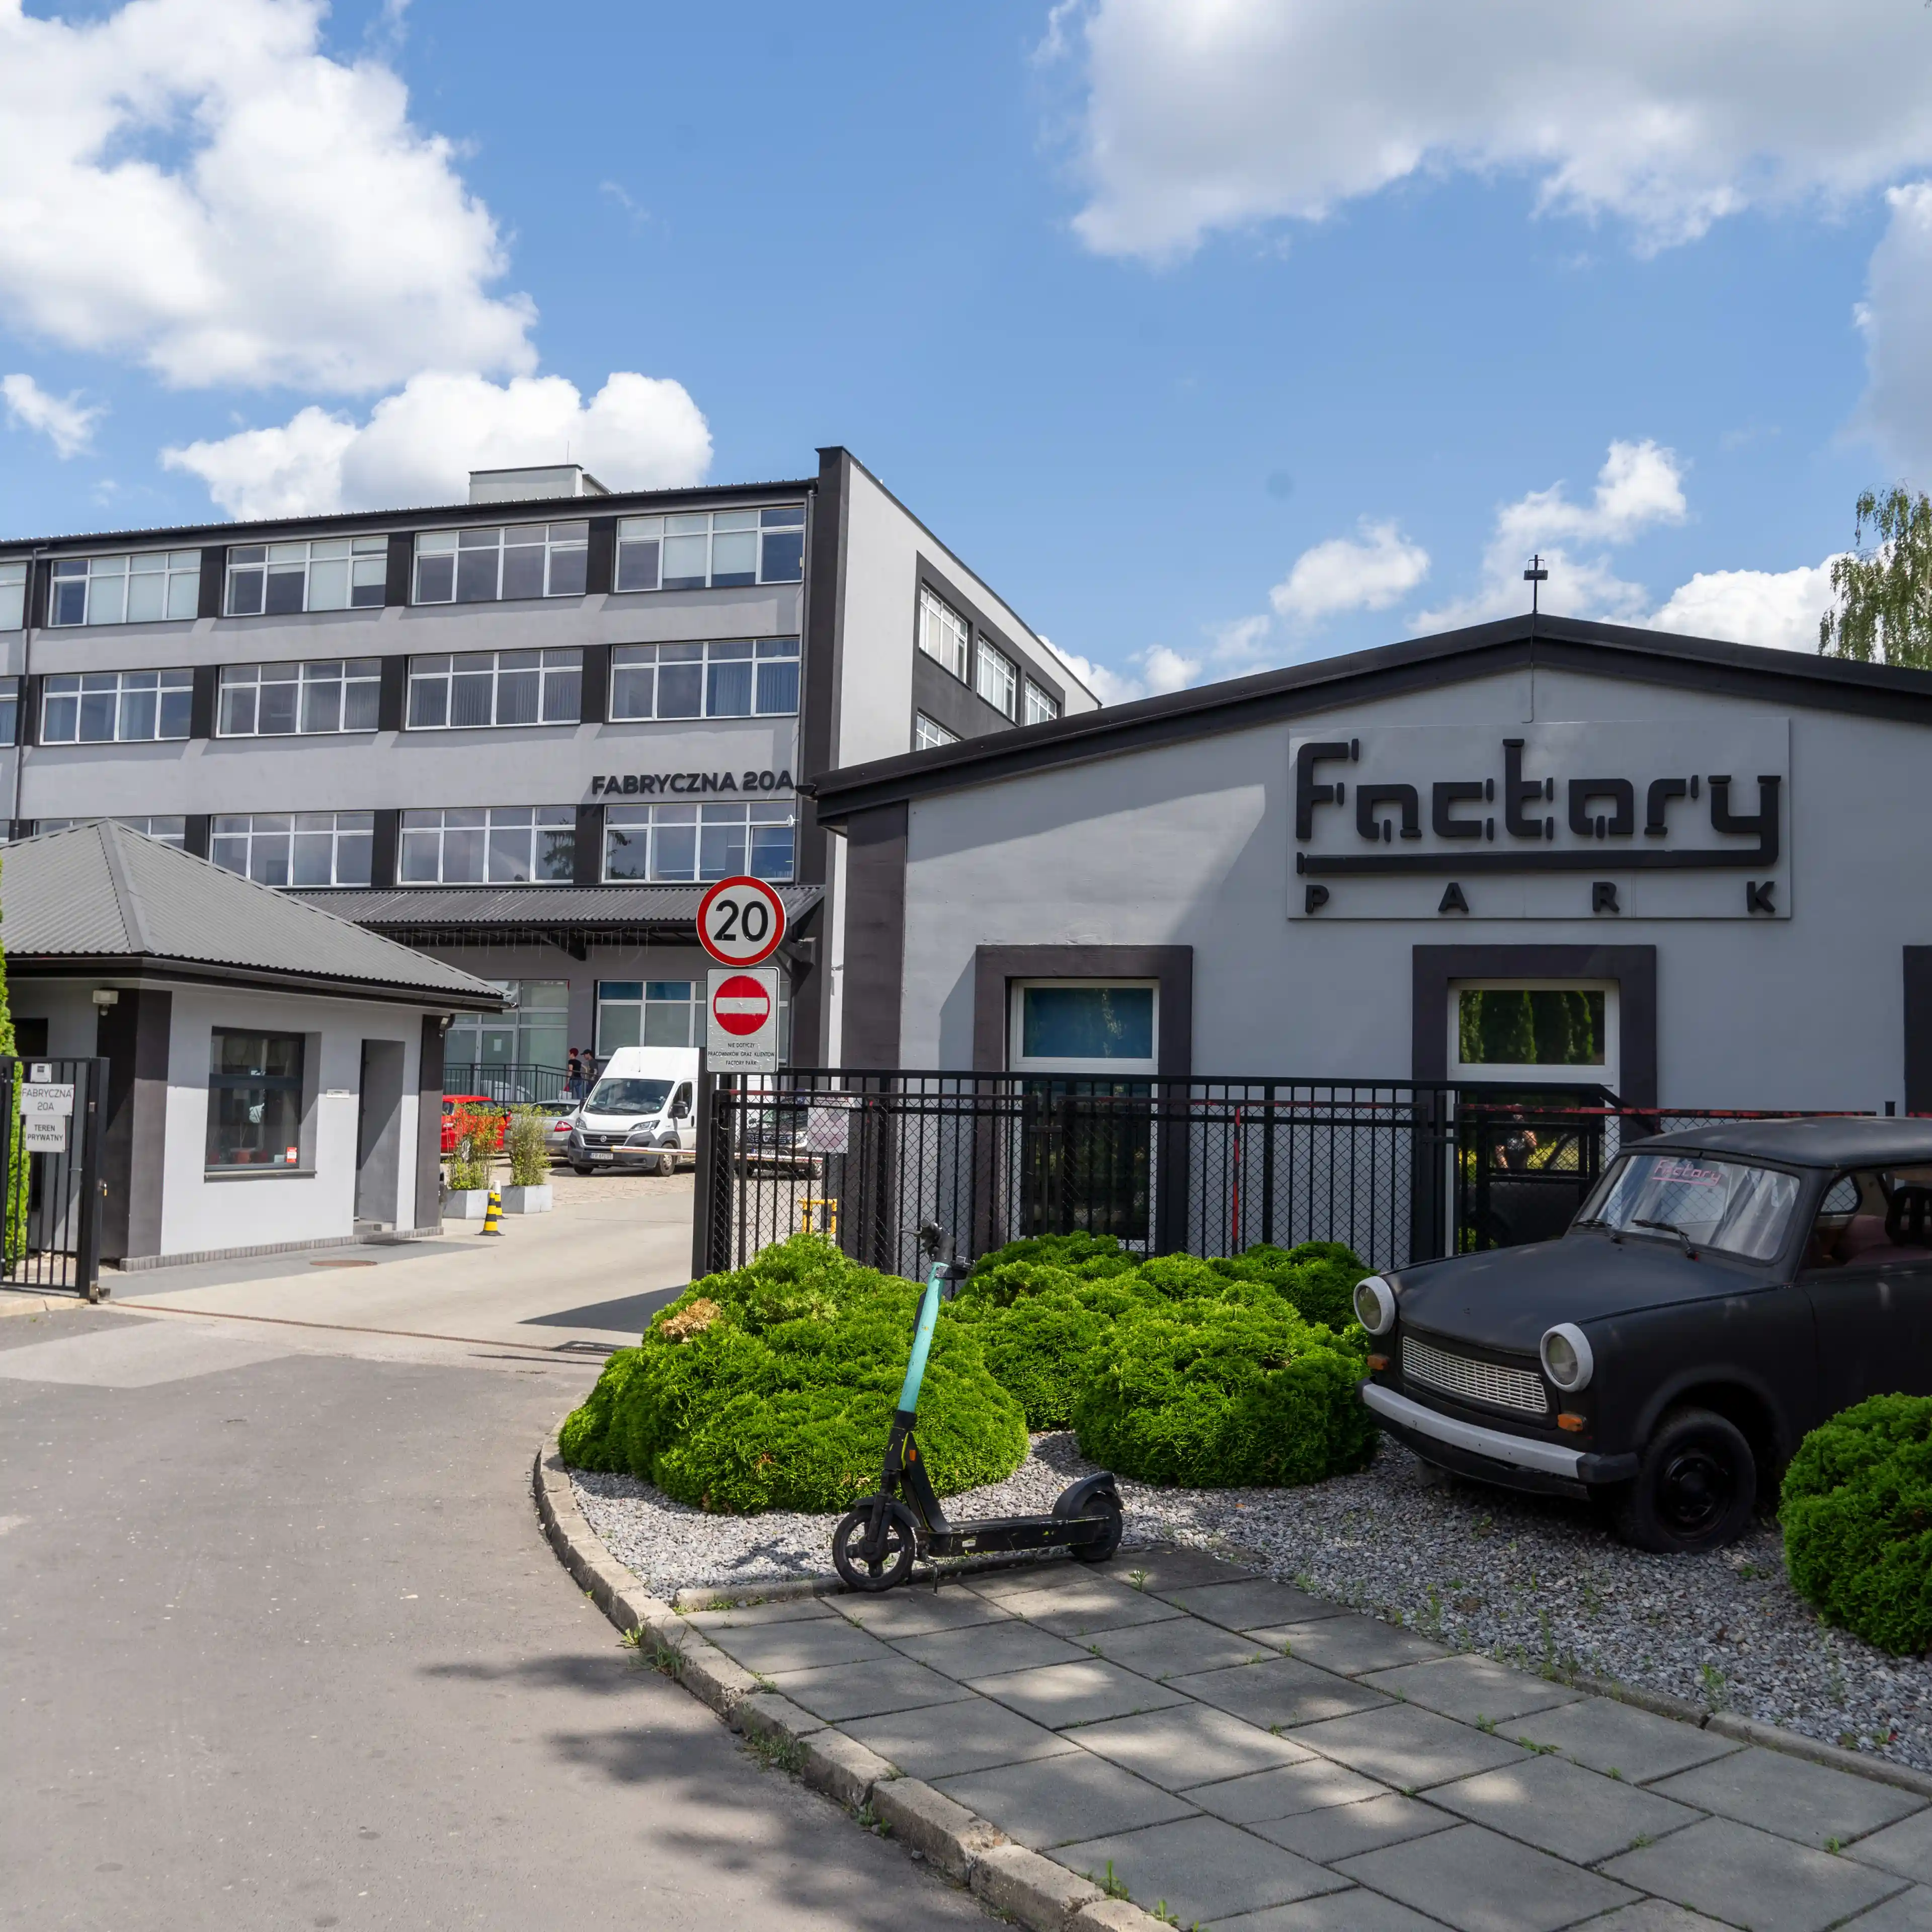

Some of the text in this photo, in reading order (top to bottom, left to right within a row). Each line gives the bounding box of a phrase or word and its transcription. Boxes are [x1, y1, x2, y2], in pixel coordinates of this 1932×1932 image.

[592, 770, 794, 794] FABRYCZNA 20A
[1296, 739, 1781, 874] Factory
[713, 900, 768, 942] 20
[22, 1089, 71, 1097] FABRYCZNA
[37, 1102, 54, 1111] 20A
[1651, 1159, 1721, 1186] Factory
